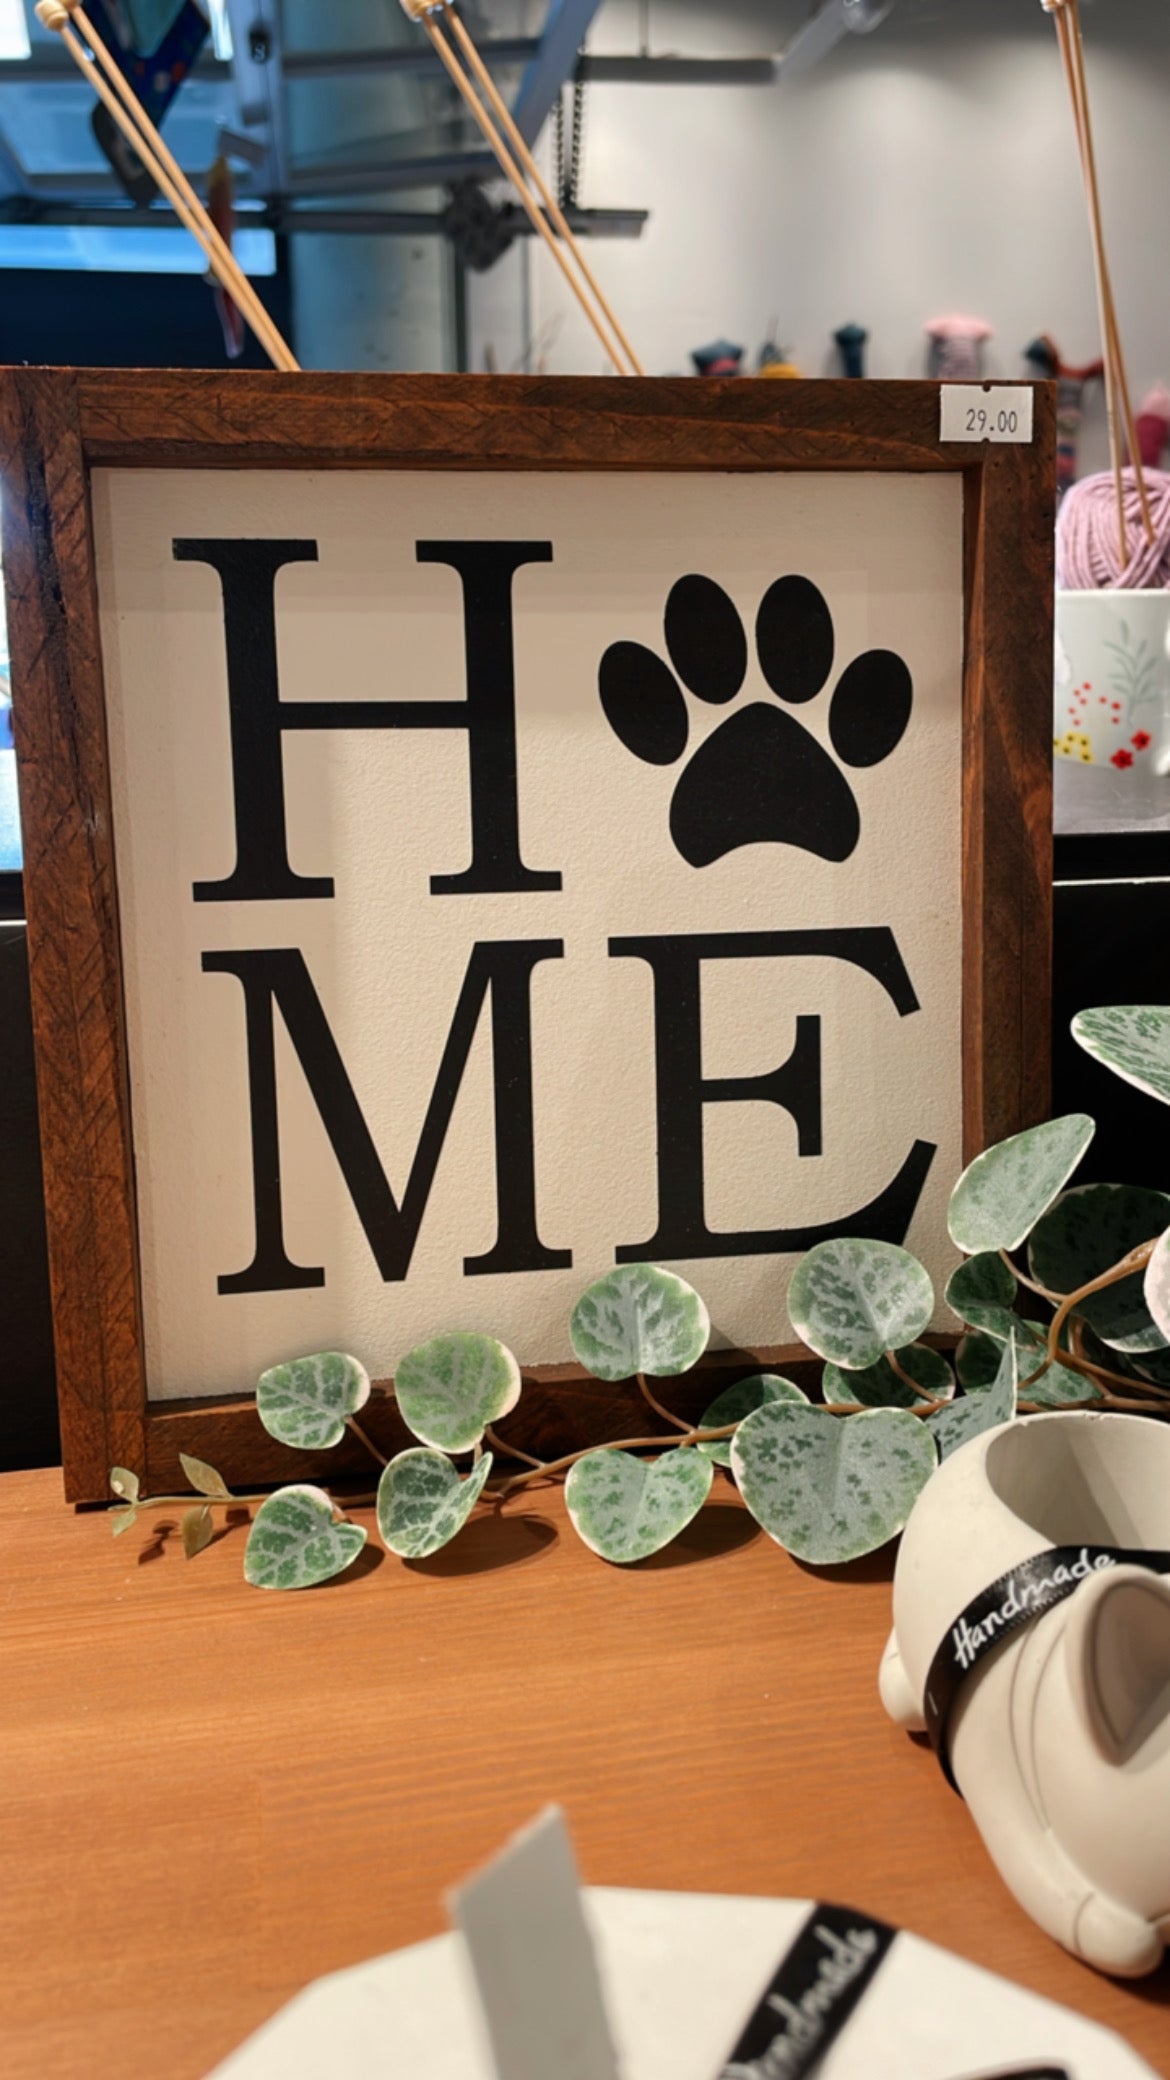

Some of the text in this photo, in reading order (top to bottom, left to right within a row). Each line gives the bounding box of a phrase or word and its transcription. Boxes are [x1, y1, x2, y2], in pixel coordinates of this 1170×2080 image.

[966, 408, 1018, 433] 29.00
[172, 538, 562, 902] H
[202, 927, 937, 1294] ME
[953, 1548, 1117, 1669] Handmade
